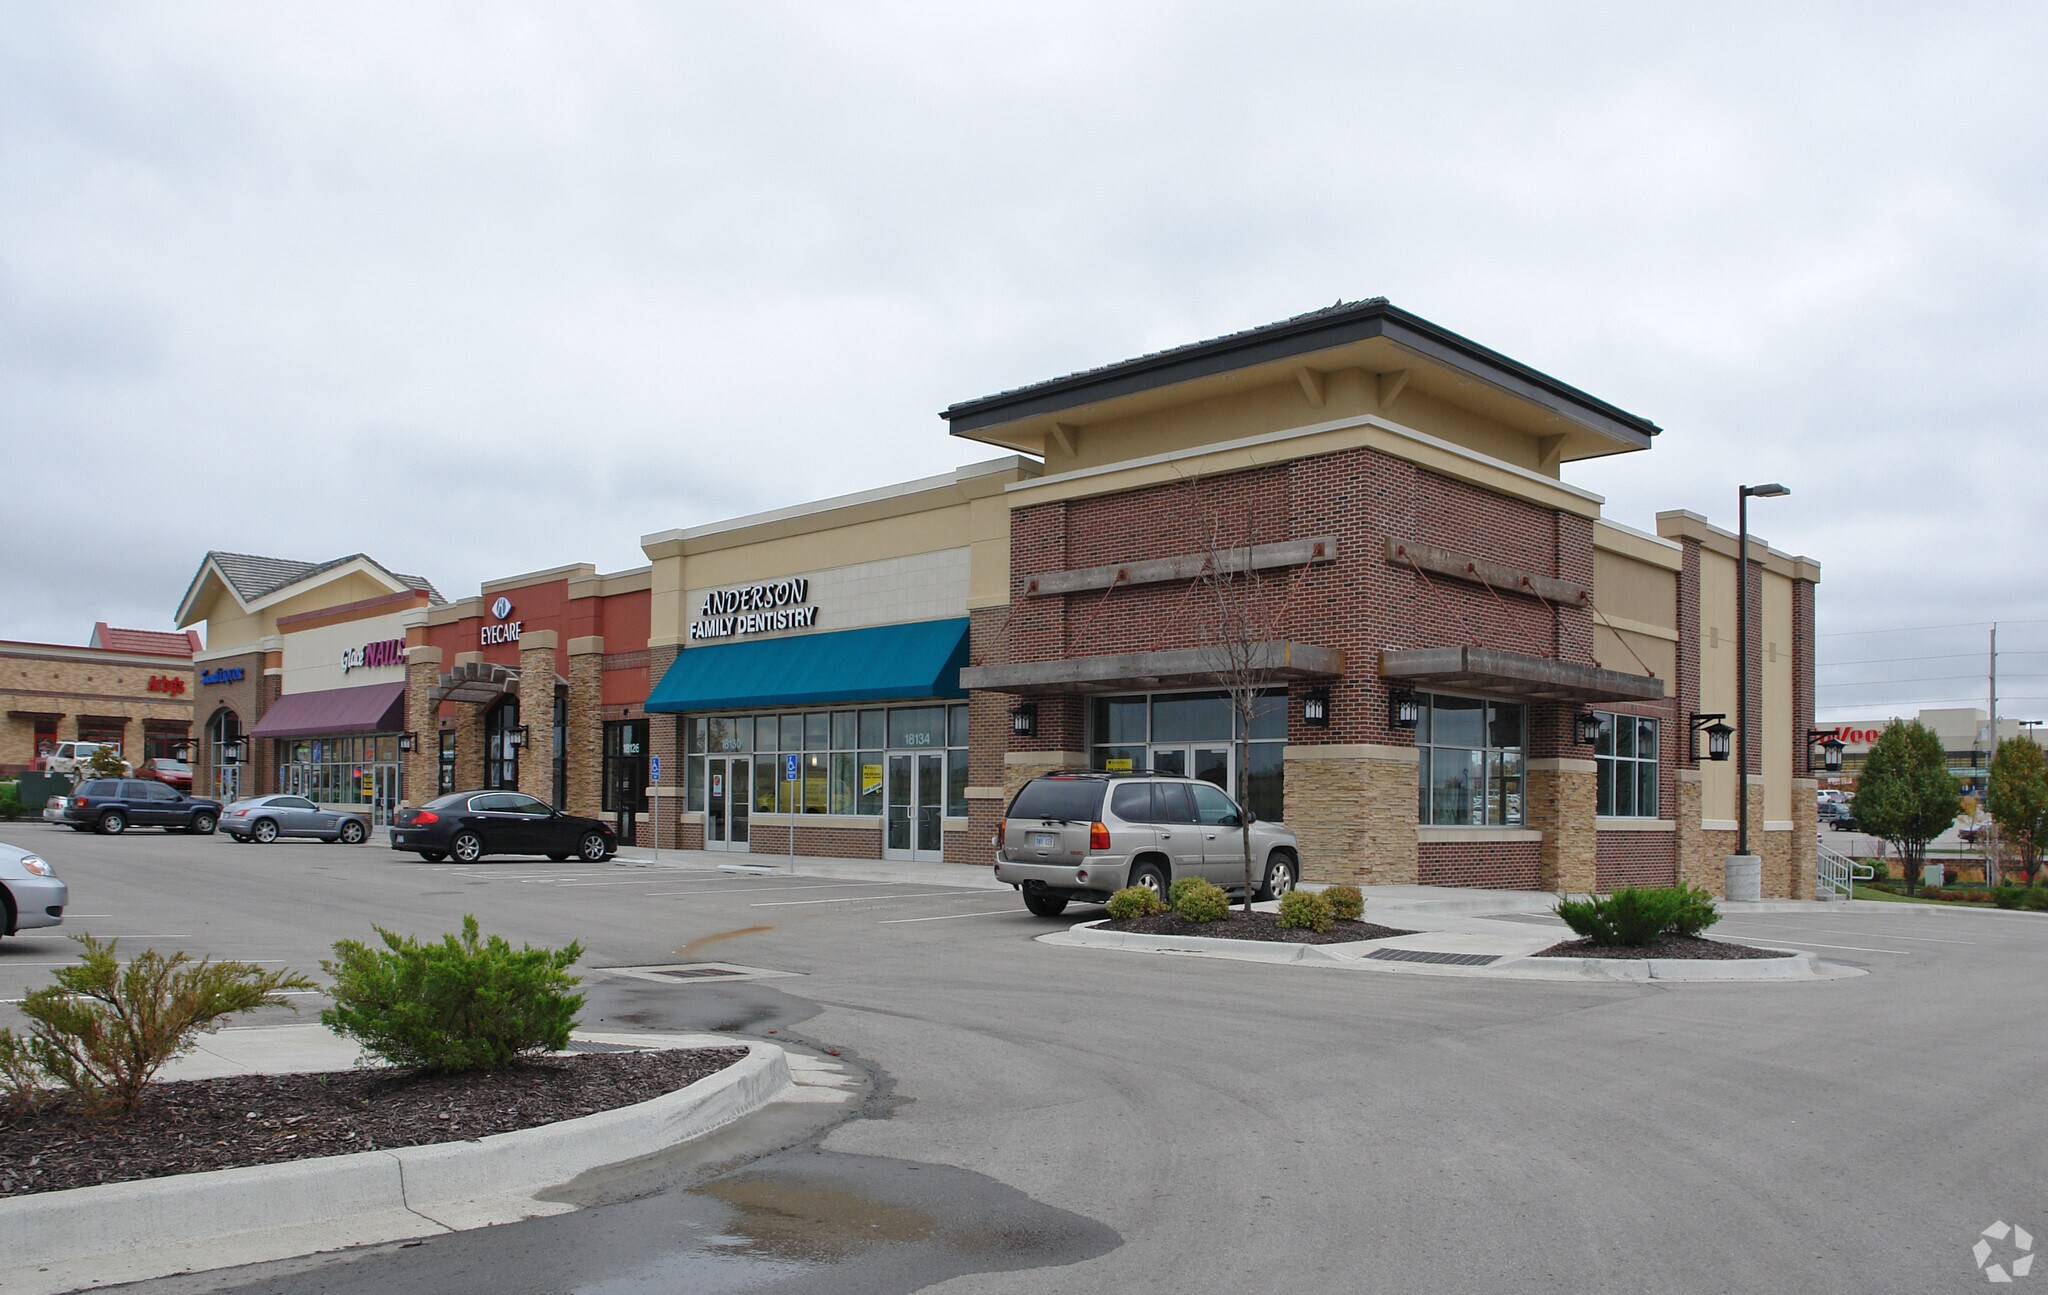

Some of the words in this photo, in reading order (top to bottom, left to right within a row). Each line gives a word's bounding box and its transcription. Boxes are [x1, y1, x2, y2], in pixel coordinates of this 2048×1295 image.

[701, 578, 808, 616] ANDERSON
[481, 621, 522, 646] EYECARE
[690, 617, 738, 640] FAMILY
[738, 606, 818, 634] DENTISTRY
[364, 637, 406, 668] NAILS
[147, 675, 186, 697] Arby's
[623, 743, 640, 754] 18126
[721, 739, 743, 750] 18130
[905, 733, 931, 745] 18134
